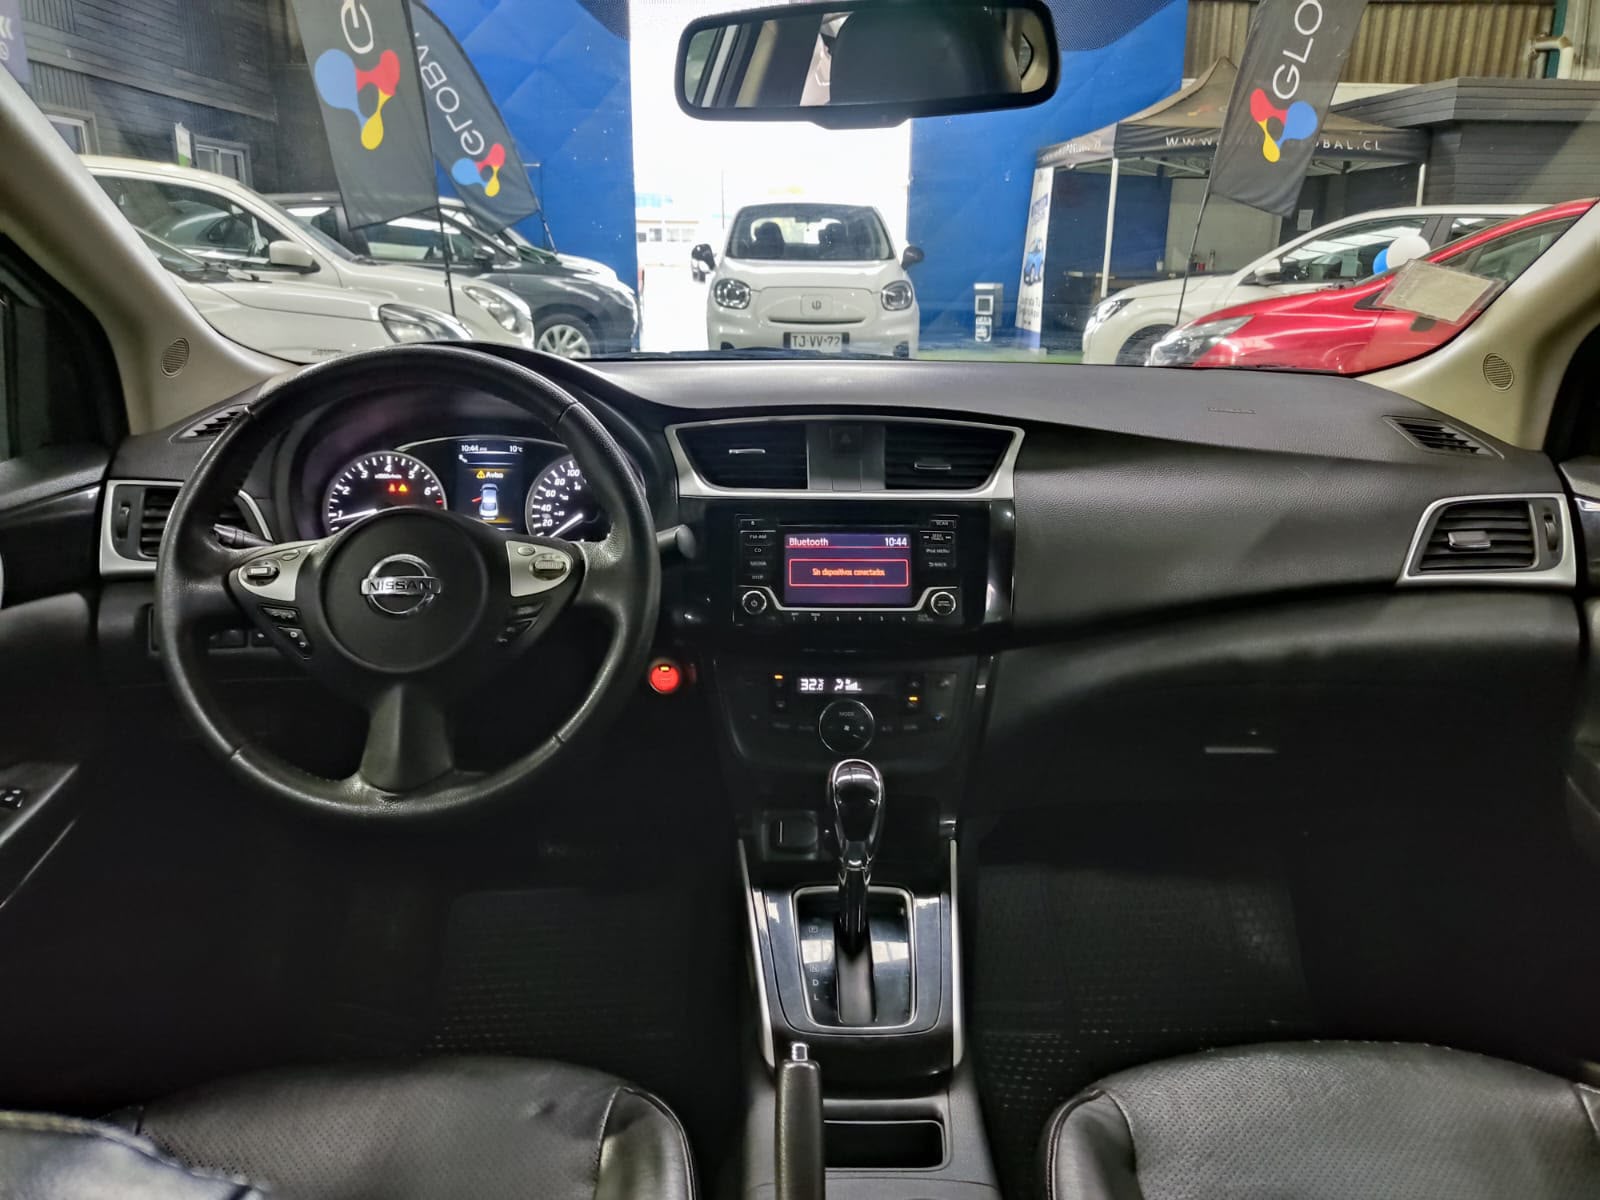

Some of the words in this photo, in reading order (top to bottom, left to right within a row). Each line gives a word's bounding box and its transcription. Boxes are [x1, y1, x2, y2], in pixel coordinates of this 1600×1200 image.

[384, 464, 392, 472] 4
[360, 470, 369, 479] 3
[407, 470, 416, 479] 5
[567, 469, 580, 477] 100
[554, 478, 566, 486] 80
[341, 486, 351, 495] 2
[423, 487, 432, 496] 6
[545, 489, 556, 498] 60
[541, 504, 552, 512] 40
[542, 519, 553, 527] 20
[788, 537, 829, 547] Bluetooth
[884, 537, 908, 547] 10:44
[368, 580, 433, 592] NISSAN
